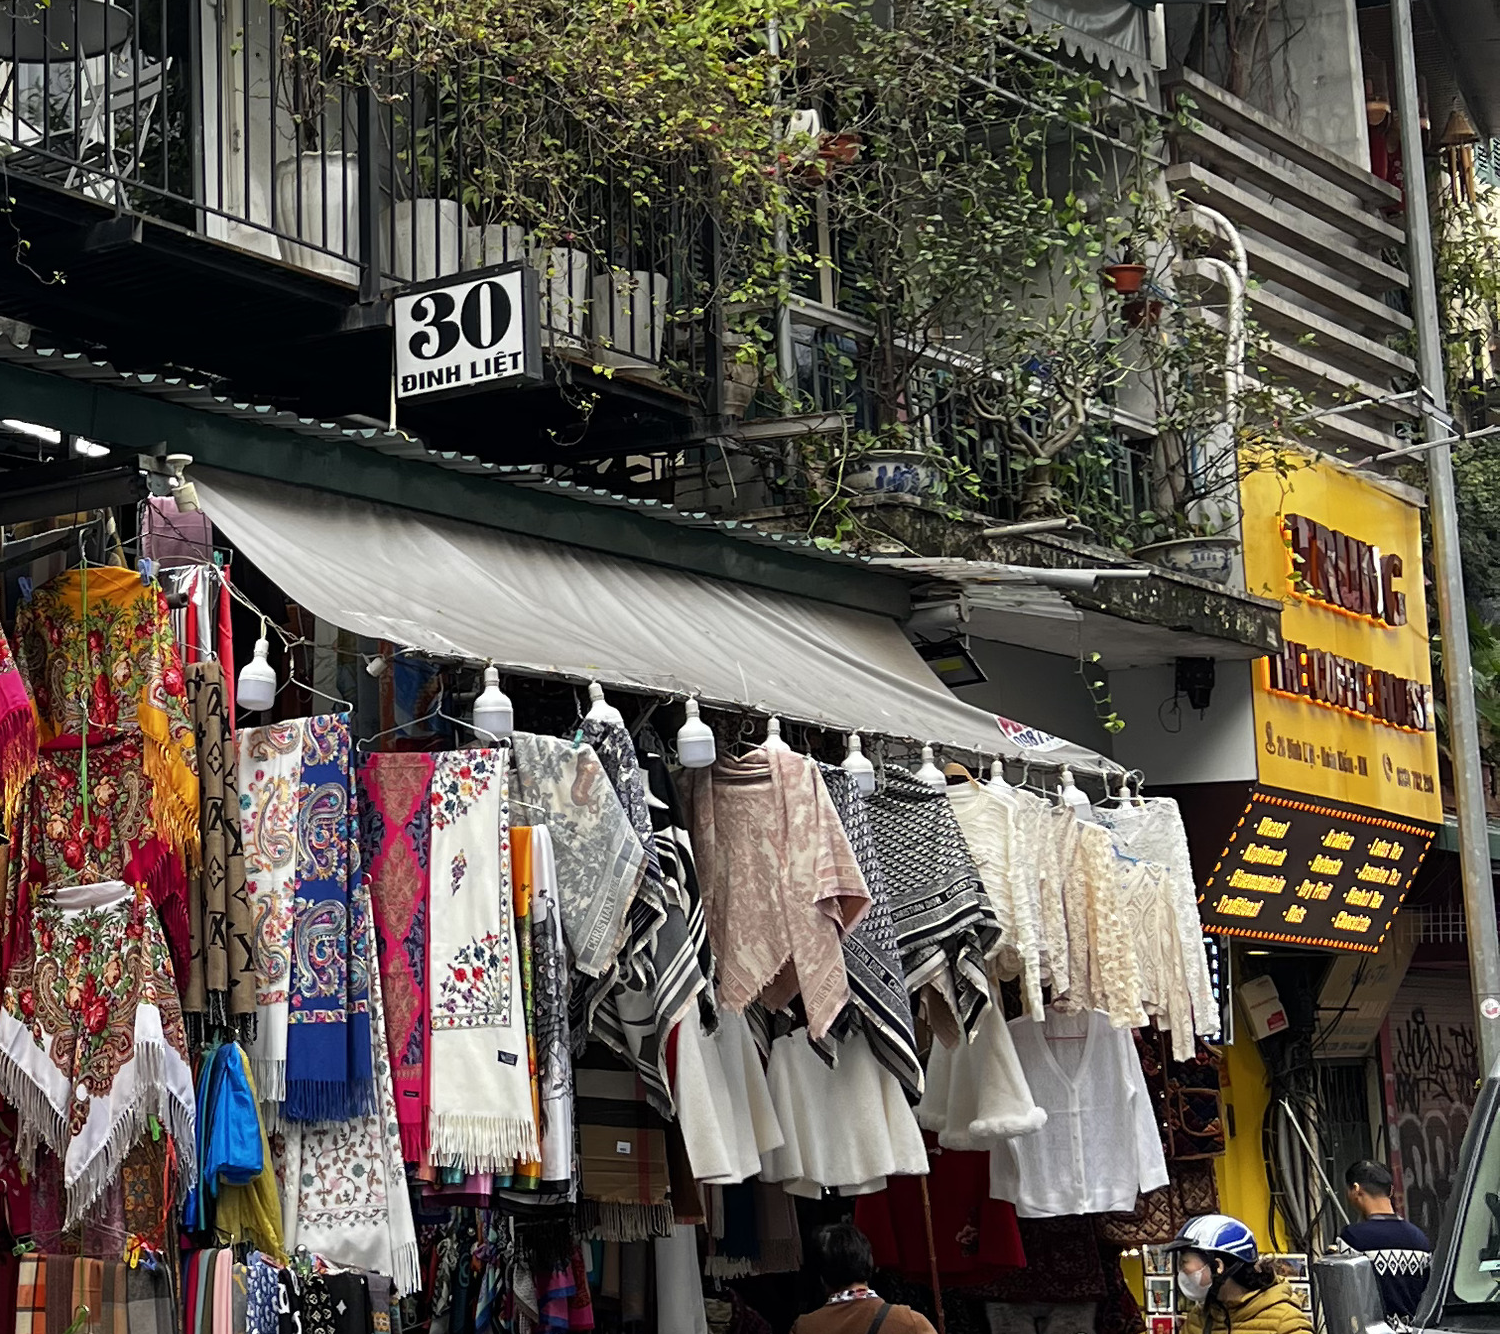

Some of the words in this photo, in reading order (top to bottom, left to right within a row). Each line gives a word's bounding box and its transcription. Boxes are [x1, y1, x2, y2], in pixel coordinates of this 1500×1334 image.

[408, 280, 512, 360] 30
[401, 364, 461, 393] ĐINH
[470, 351, 522, 378] LIỆT
